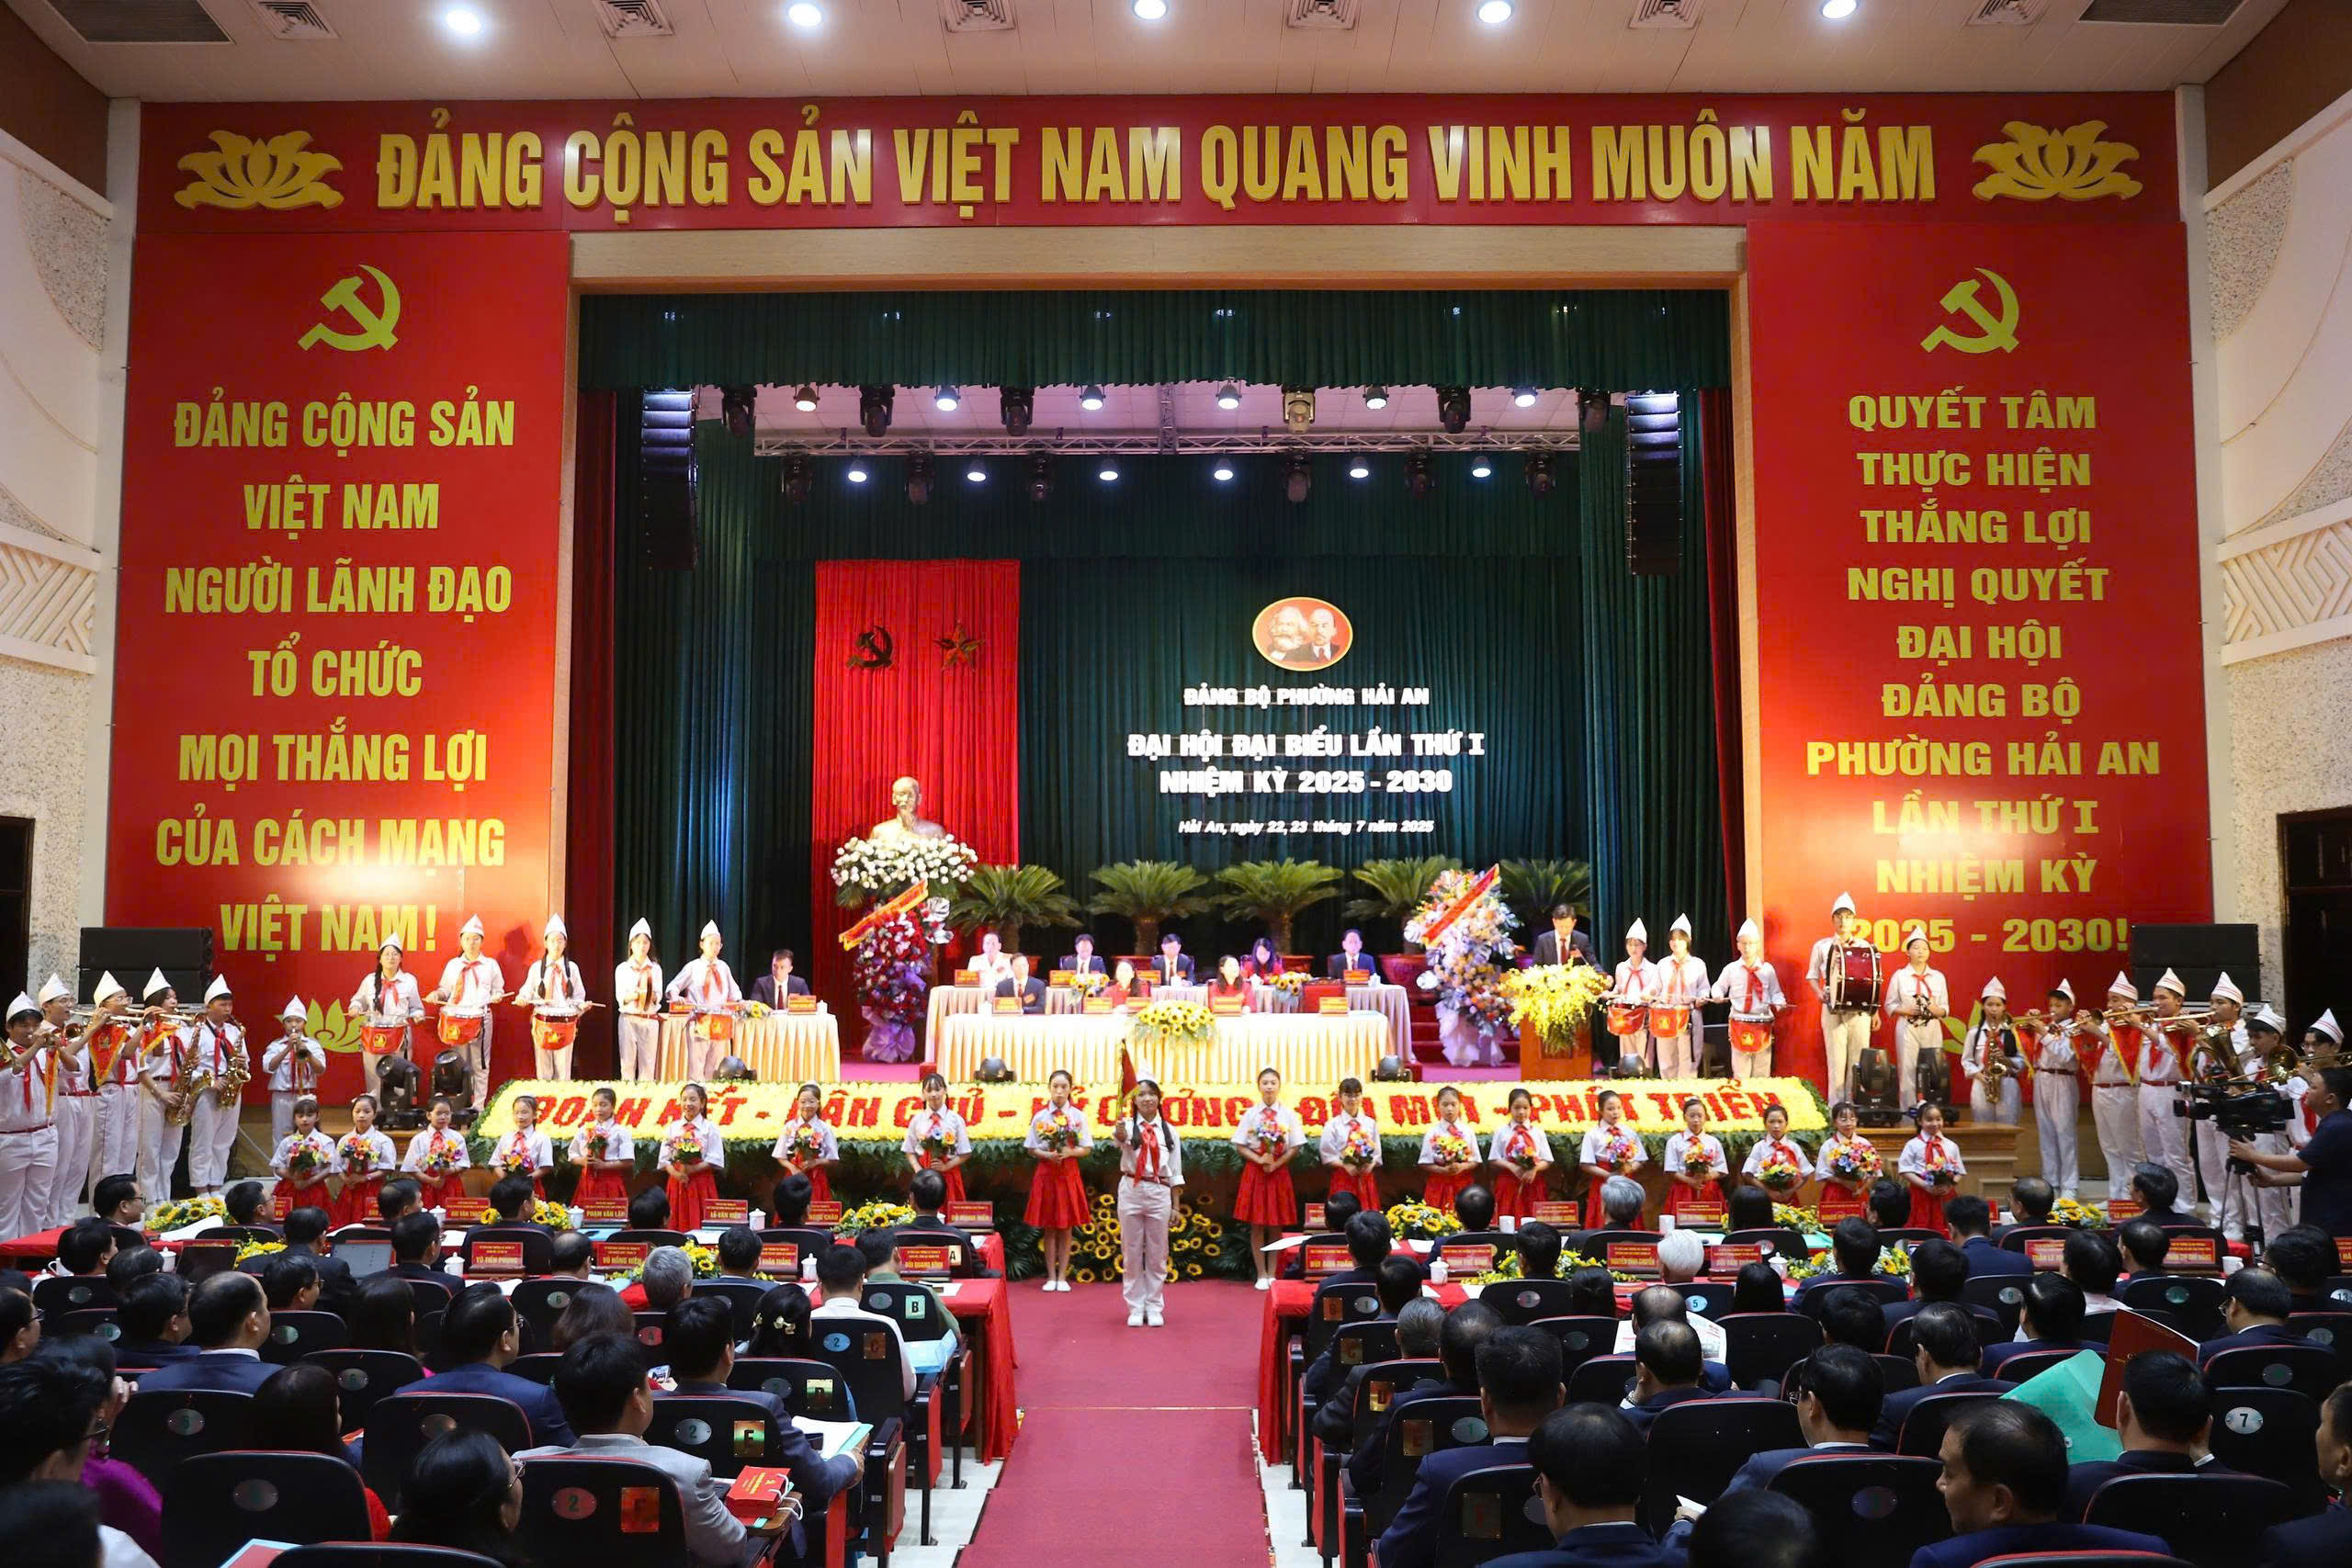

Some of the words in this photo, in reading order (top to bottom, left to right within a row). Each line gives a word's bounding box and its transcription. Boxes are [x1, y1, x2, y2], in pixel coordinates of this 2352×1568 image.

[376, 107, 545, 208] ĐẢNG
[564, 112, 729, 223] CỘNG
[748, 105, 872, 208] SẢN
[894, 110, 1020, 219] VIỆT
[1042, 126, 1182, 203] NAM
[1200, 125, 1408, 210] QUANG
[1428, 125, 1571, 201] VINH
[1591, 108, 1773, 201] MUÔN
[1789, 107, 1935, 201] NĂM
[174, 387, 288, 447] ĐẢNG
[302, 393, 414, 457] CỘNG
[430, 385, 514, 446] SẢN
[1849, 386, 1986, 432] QUYẾT
[1999, 389, 2097, 429] TÂM
[1857, 449, 1971, 492] THỰC
[1987, 446, 2091, 492] HIỆN
[243, 474, 331, 540] VIỆT
[343, 484, 439, 529] NAM
[1860, 498, 2008, 544] THẮNG
[2024, 507, 2091, 550] LỢI
[165, 556, 292, 613] NGƯỜI
[307, 558, 413, 613] LÃNH
[428, 566, 512, 623] ĐẠO
[1848, 567, 1955, 608] NGHỊ
[1971, 558, 2109, 605] QUYẾT
[248, 631, 300, 696] TỔ
[311, 640, 423, 697] CHỨC
[1896, 626, 1972, 666] ĐẠI
[1988, 620, 2062, 666] HỘI
[1183, 682, 1238, 705] ĐẢNG
[1244, 684, 1272, 709] BỘ
[1277, 683, 1355, 705] PHƯỜNG
[1362, 682, 1395, 705] HẢI
[1401, 688, 1430, 705] AN
[1882, 672, 2006, 717] ĐẢNG
[2022, 678, 2081, 724] BỘ
[179, 734, 258, 791] MỌI
[273, 716, 409, 781] THẮNG
[424, 729, 487, 791] LỢI
[1127, 733, 1171, 761] ĐẠI
[1180, 728, 1223, 761] HỘI
[1232, 733, 1276, 761] ĐẠI
[1285, 725, 1343, 757] BIỂU
[1410, 728, 1464, 757] THỨ
[1468, 733, 1485, 756] I
[1806, 734, 1992, 775] PHƯỜNG
[2007, 731, 2081, 775] HẢI
[2098, 741, 2160, 774] AN
[1159, 765, 1244, 797] NHIỆM
[1253, 765, 1288, 794] KỲ
[1298, 770, 1365, 794] 2025
[1386, 769, 1453, 793] 2030
[1204, 820, 1227, 835] An,
[1230, 819, 1264, 836] ngày
[1289, 820, 1308, 833] 23
[1312, 819, 1352, 836] tháng
[1356, 820, 1366, 833] 7
[1367, 819, 1397, 833] năm
[1400, 820, 1434, 833] 2025
[1872, 789, 1959, 835] LẦN
[1973, 794, 2064, 835] THỨ
[2074, 800, 2099, 833] I
[156, 803, 239, 866] CỦA
[254, 808, 365, 866] CÁCH
[379, 818, 504, 876] MẠNG
[1876, 853, 2024, 901] NHIỆM
[2041, 852, 2098, 894] KỲ
[220, 894, 309, 962] VIỆT
[2003, 919, 2128, 953] 2030!
[949, 1250, 957, 1261] A
[911, 1301, 920, 1314] B
[1692, 1299, 1699, 1308] 5
[833, 1337, 841, 1348] 2
[689, 1425, 697, 1439] 2
[2239, 1413, 2249, 1427] 7
[567, 1495, 580, 1512] 2
